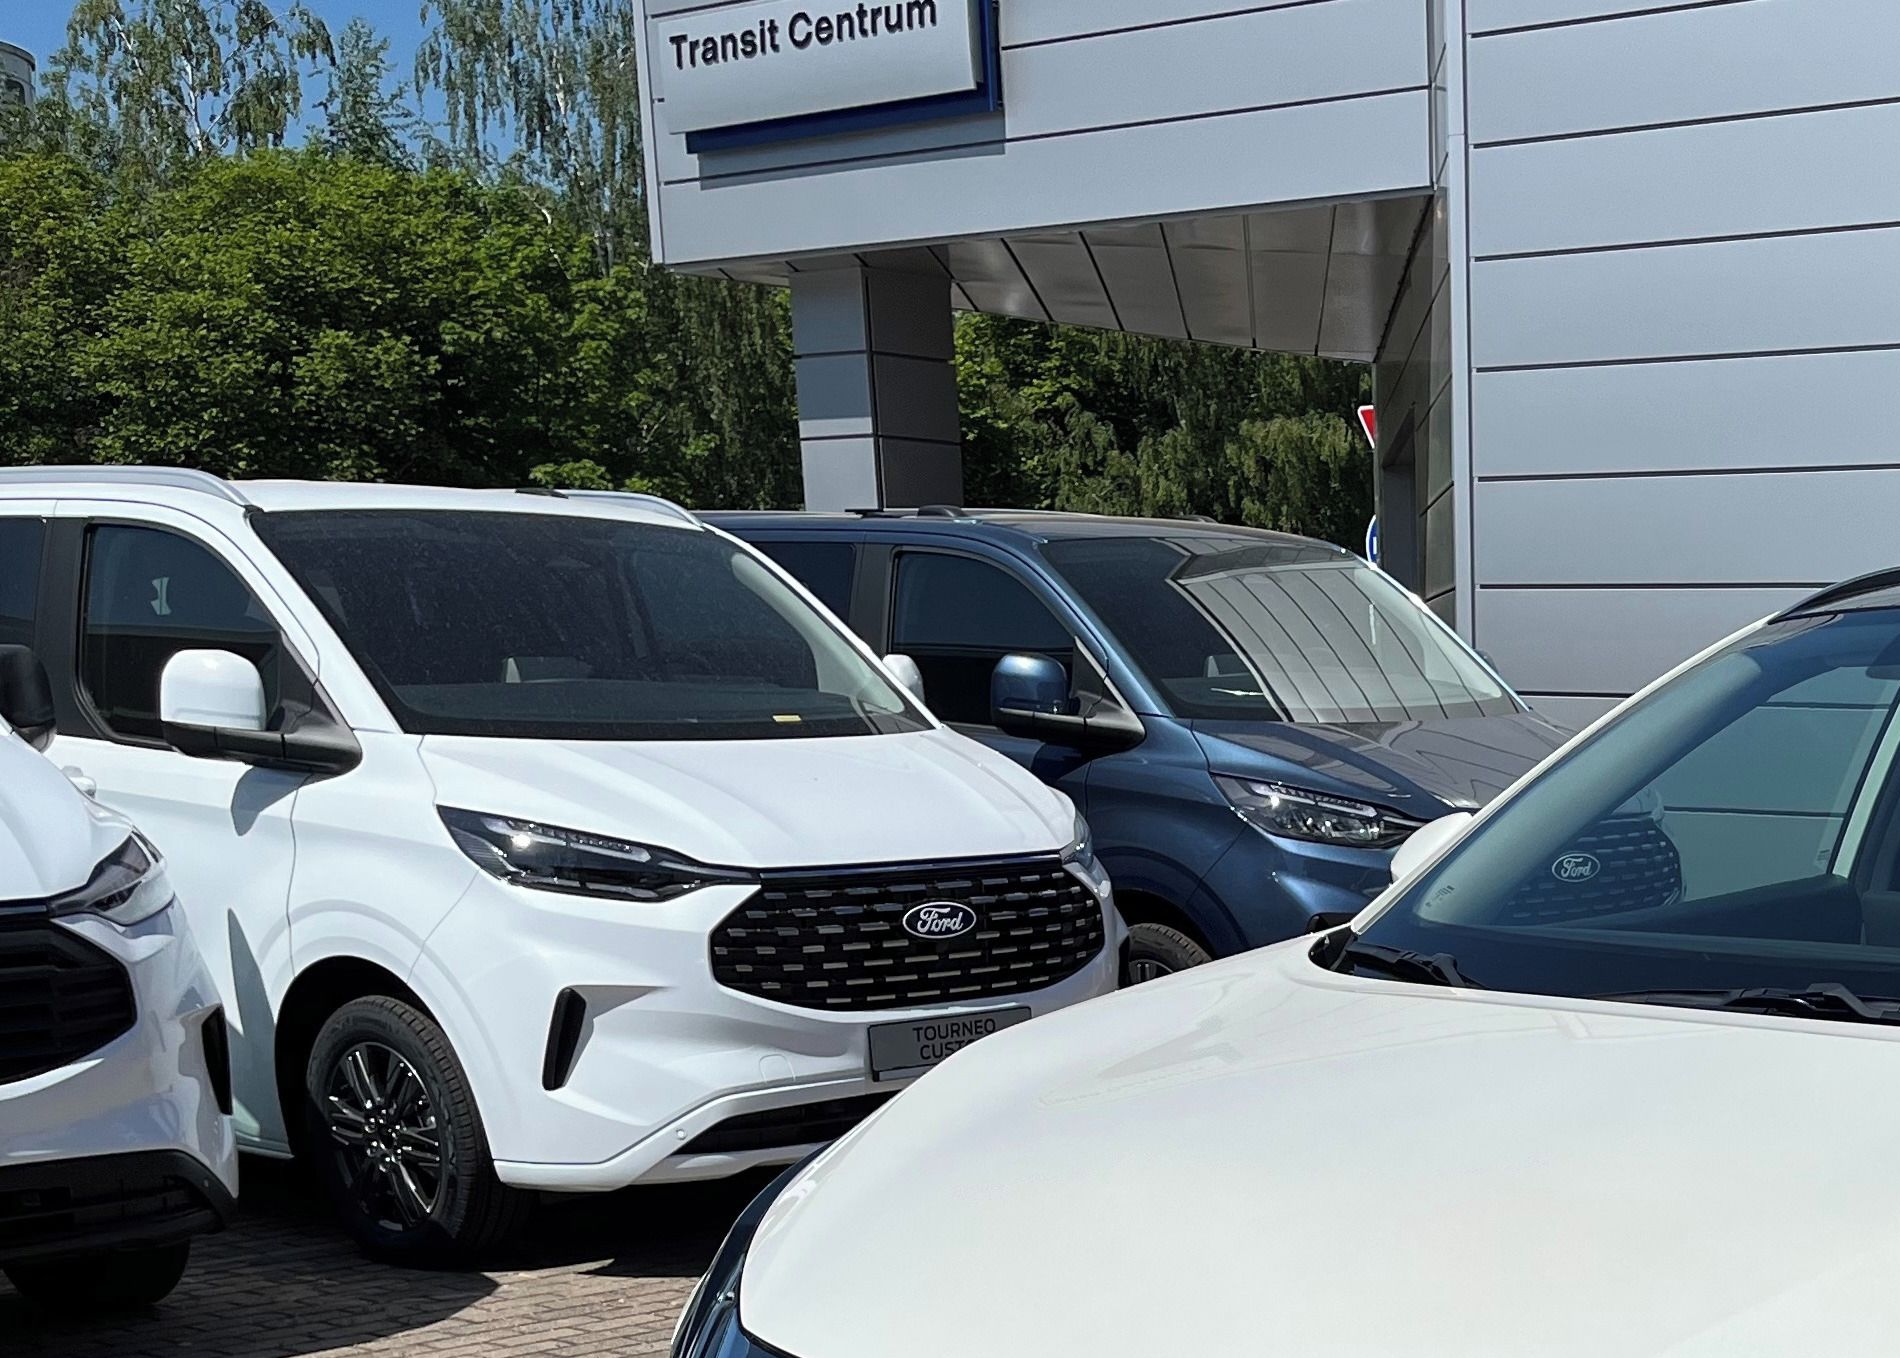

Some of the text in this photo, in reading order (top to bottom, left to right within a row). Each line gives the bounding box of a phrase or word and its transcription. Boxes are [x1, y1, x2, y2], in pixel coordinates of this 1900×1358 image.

[669, 0, 938, 71] Transit Centrum
[912, 1018, 996, 1042] TOURNEO
[920, 1039, 976, 1060] CUST
